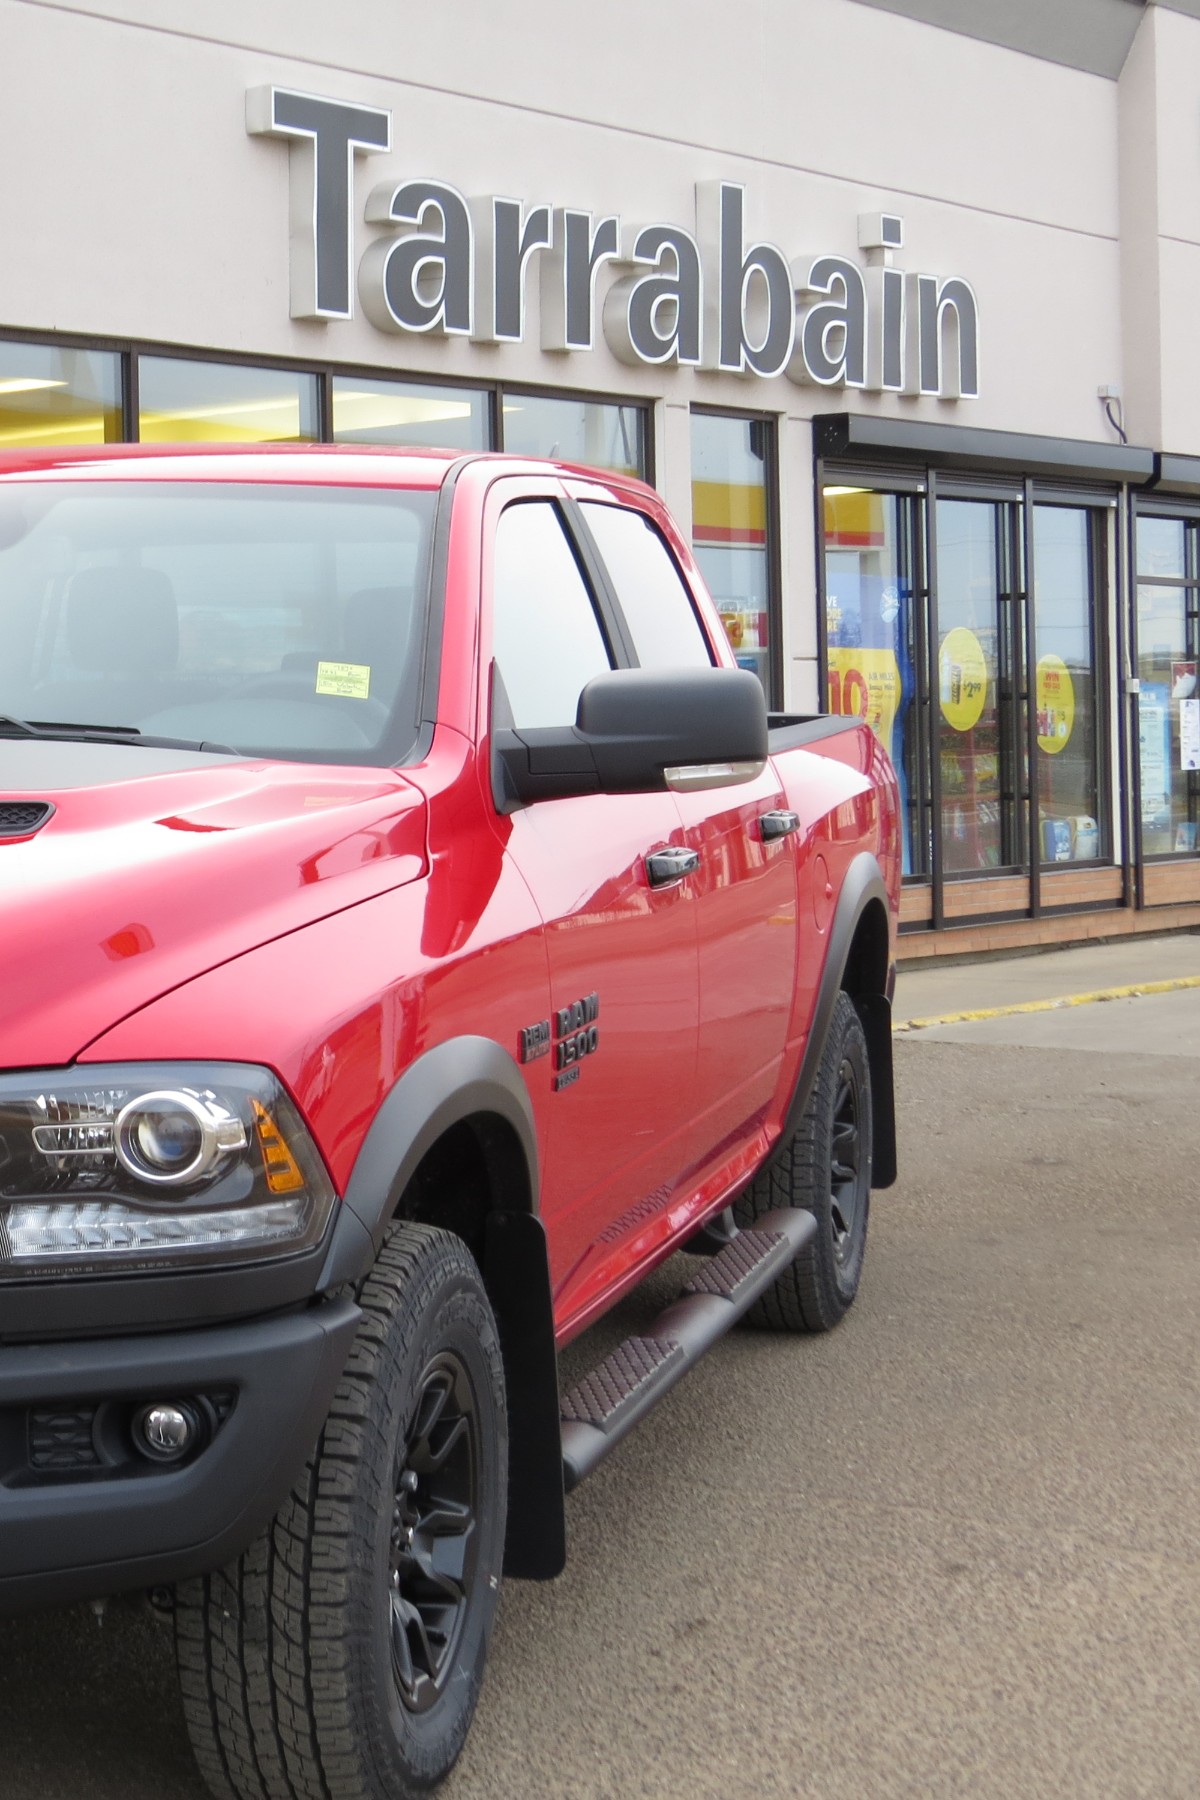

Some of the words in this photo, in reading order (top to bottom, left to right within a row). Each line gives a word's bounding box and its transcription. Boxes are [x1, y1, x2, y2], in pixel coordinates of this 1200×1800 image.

[264, 85, 980, 401] Tarrabain
[556, 990, 598, 1037] RAM
[556, 1025, 598, 1071] 1500
